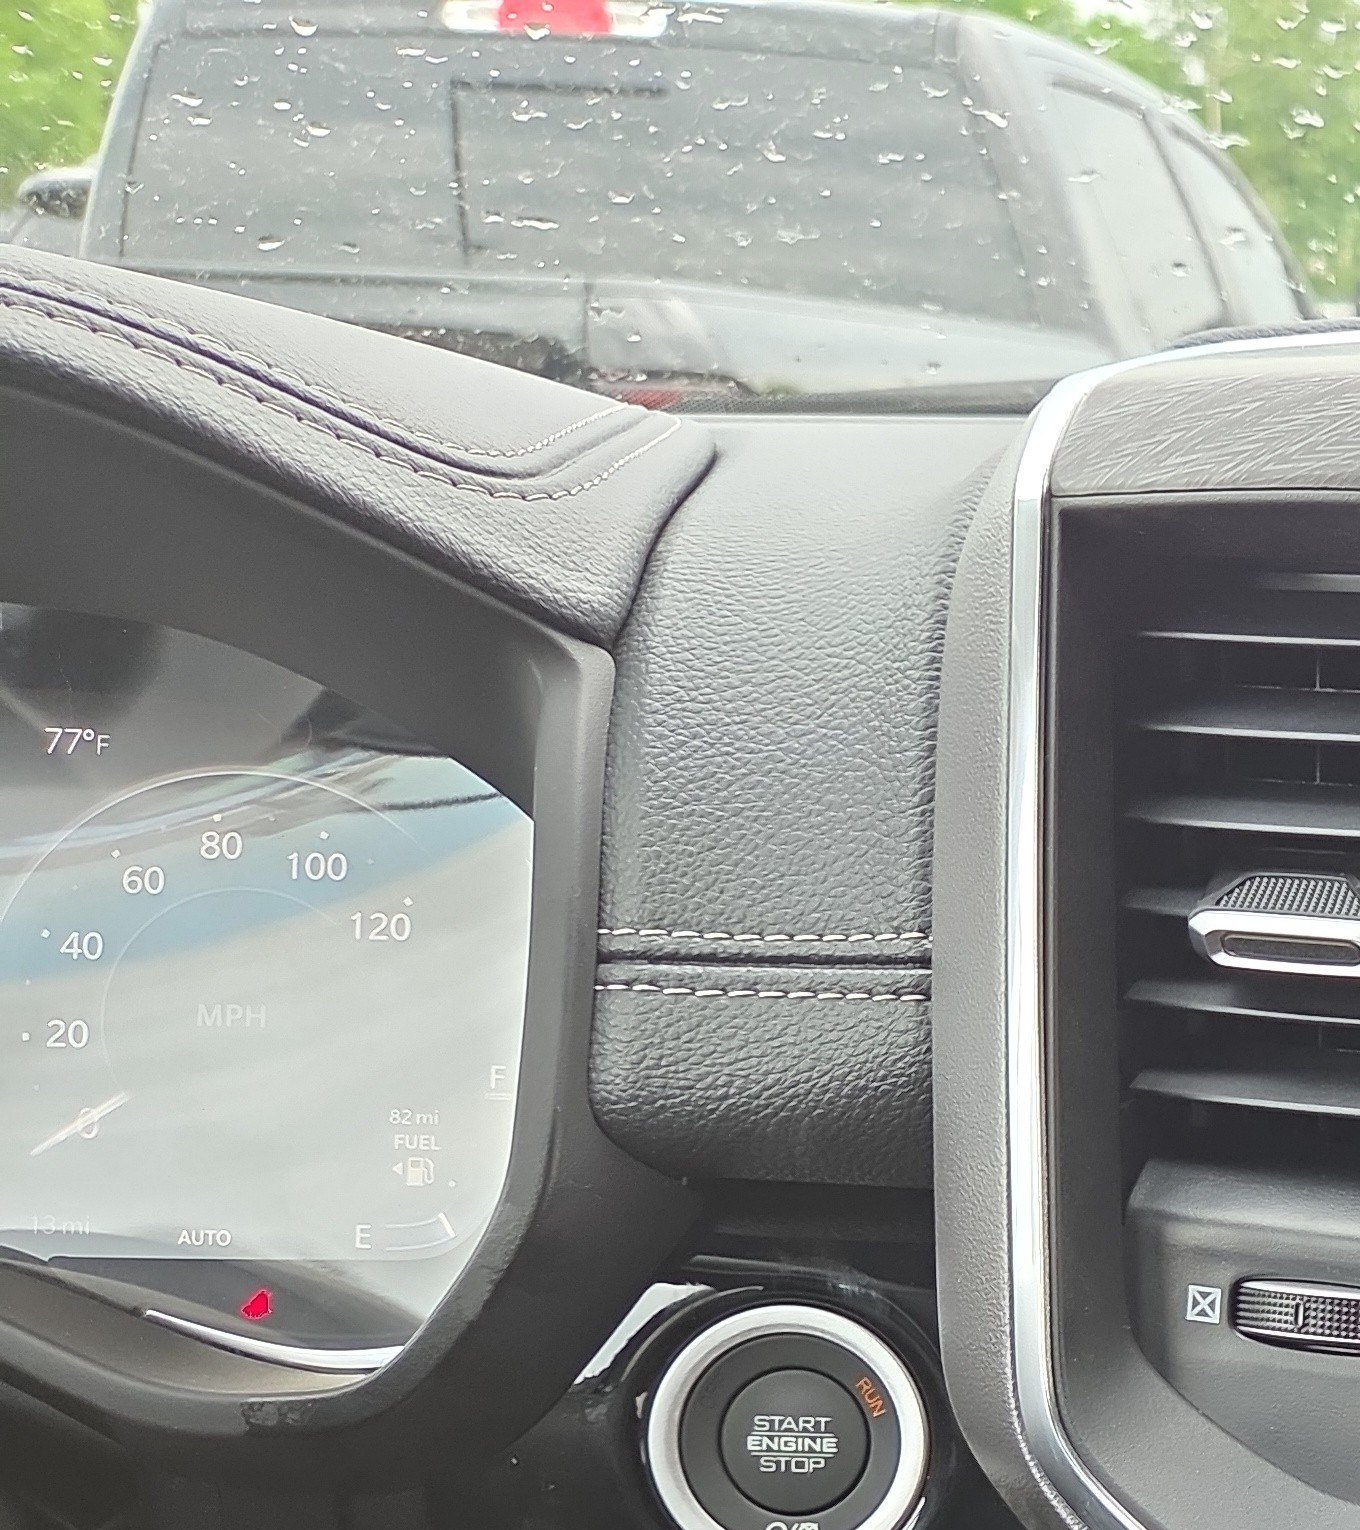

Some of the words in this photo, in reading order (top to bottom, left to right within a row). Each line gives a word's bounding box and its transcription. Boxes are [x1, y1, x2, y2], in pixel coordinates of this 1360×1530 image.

[200, 831, 243, 858] 80
[287, 852, 348, 881] 100
[122, 865, 165, 893] 60
[350, 913, 411, 941] 120
[60, 931, 104, 959] 40
[196, 1003, 267, 1028] MPH
[45, 1020, 89, 1049] 20
[490, 1065, 506, 1089] F
[389, 1109, 412, 1125] 82
[416, 1110, 439, 1125] mi
[394, 1134, 441, 1151] FUEL
[32, 1214, 56, 1235] 13
[62, 1214, 91, 1235] mi
[177, 1228, 231, 1247] AUTO
[355, 1225, 371, 1249] E
[855, 1376, 886, 1419] RUN
[753, 1415, 832, 1432] START
[747, 1435, 838, 1453] ENGINE
[759, 1457, 825, 1473] STOP
